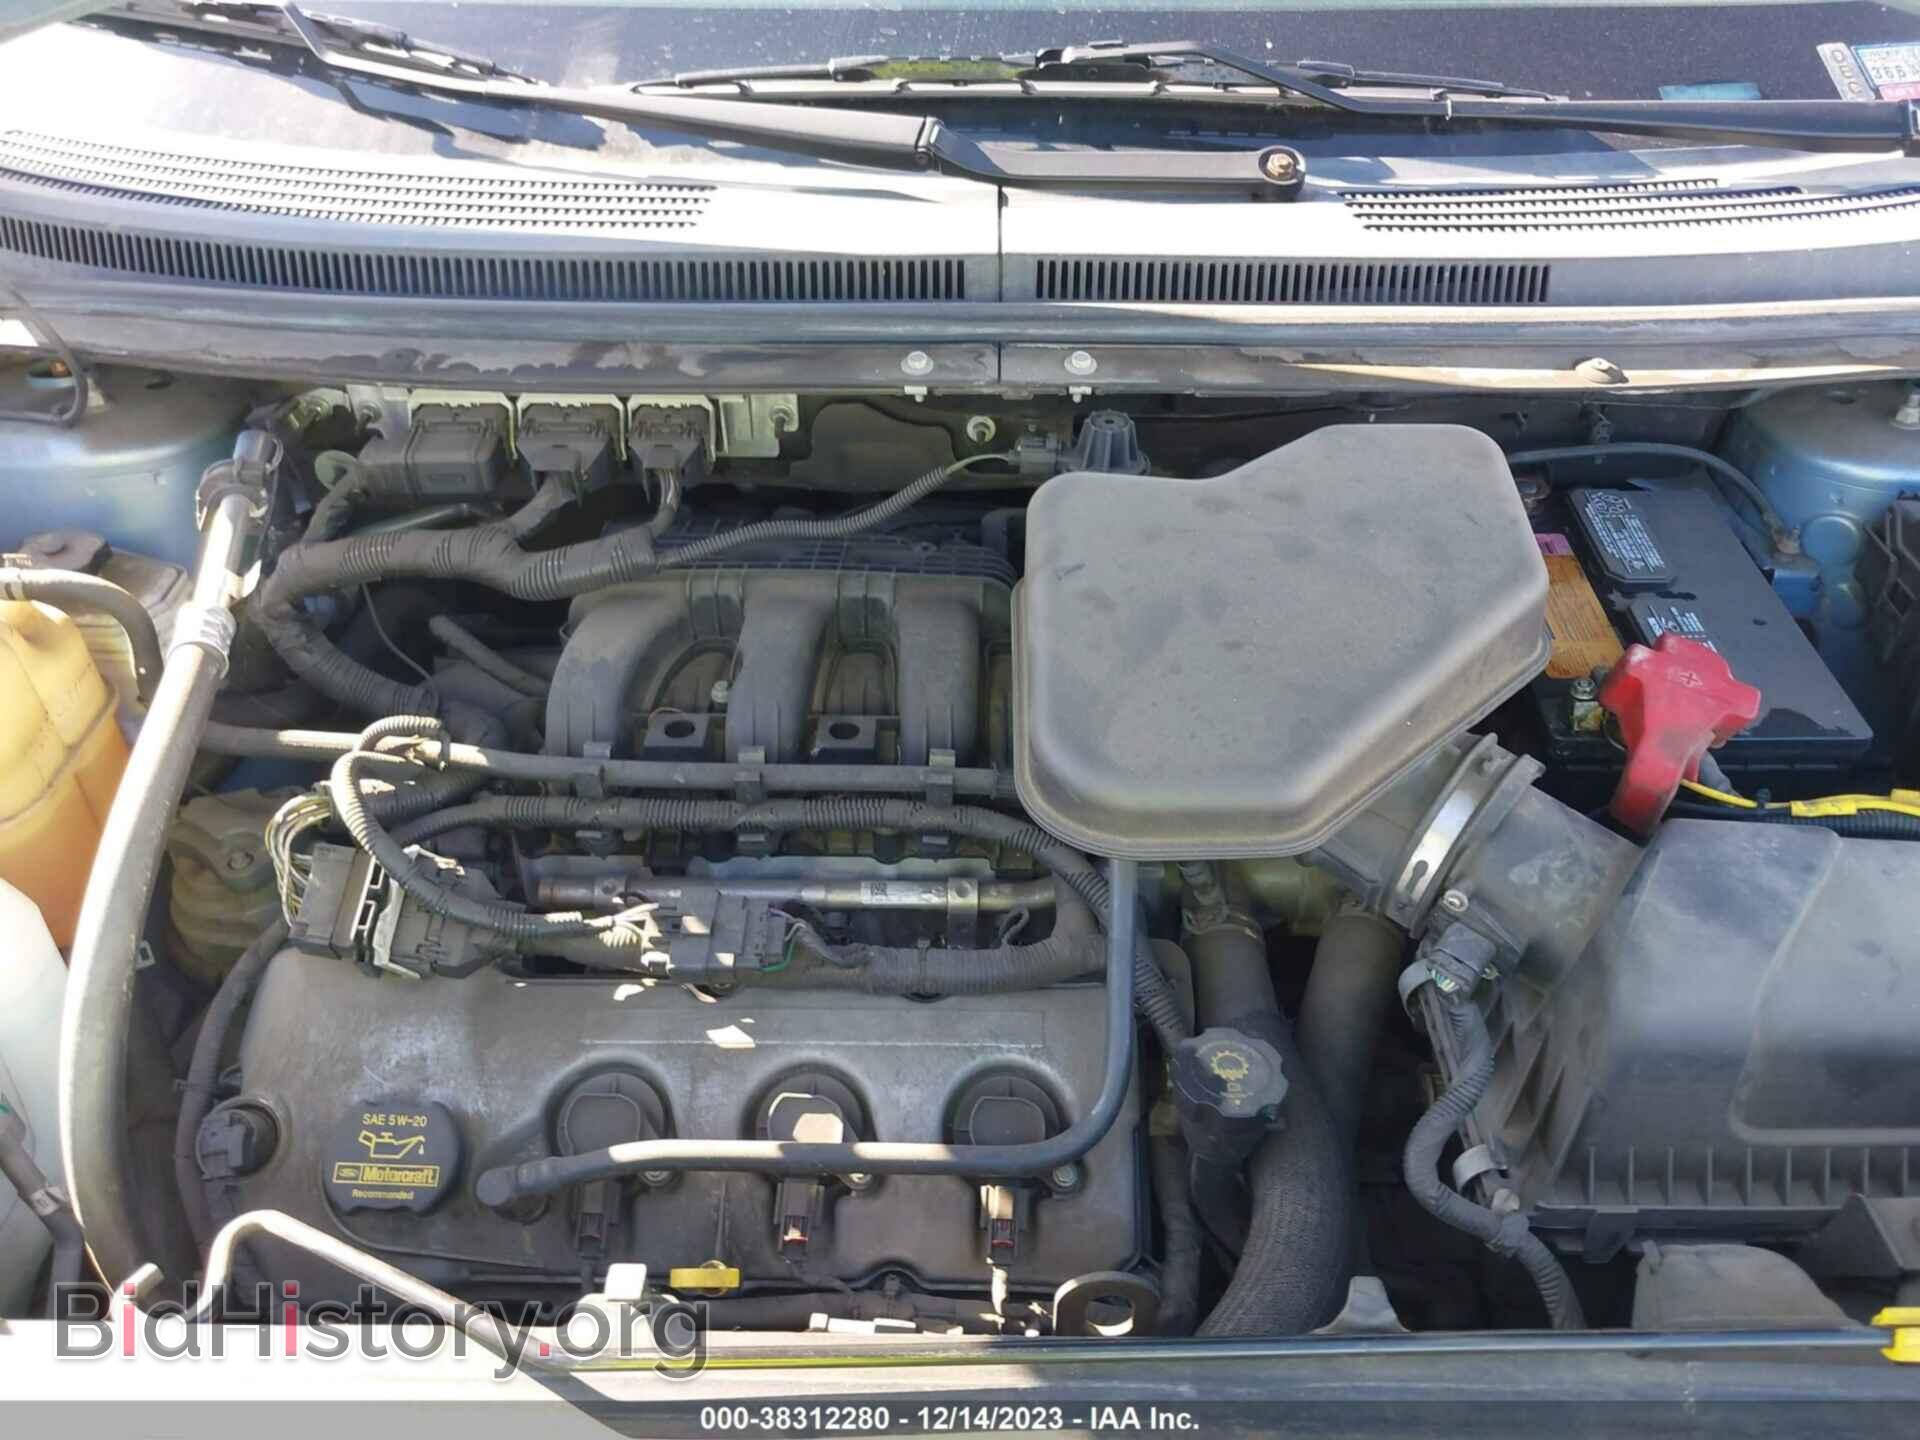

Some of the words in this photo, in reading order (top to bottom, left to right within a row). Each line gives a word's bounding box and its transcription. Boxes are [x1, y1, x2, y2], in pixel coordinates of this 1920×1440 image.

[1831, 49, 1863, 95] DEC
[362, 1113, 386, 1126] SAE
[388, 1114, 428, 1127] 5W-20
[363, 1166, 434, 1184] Motorcraft
[351, 1189, 414, 1200] Recommended
